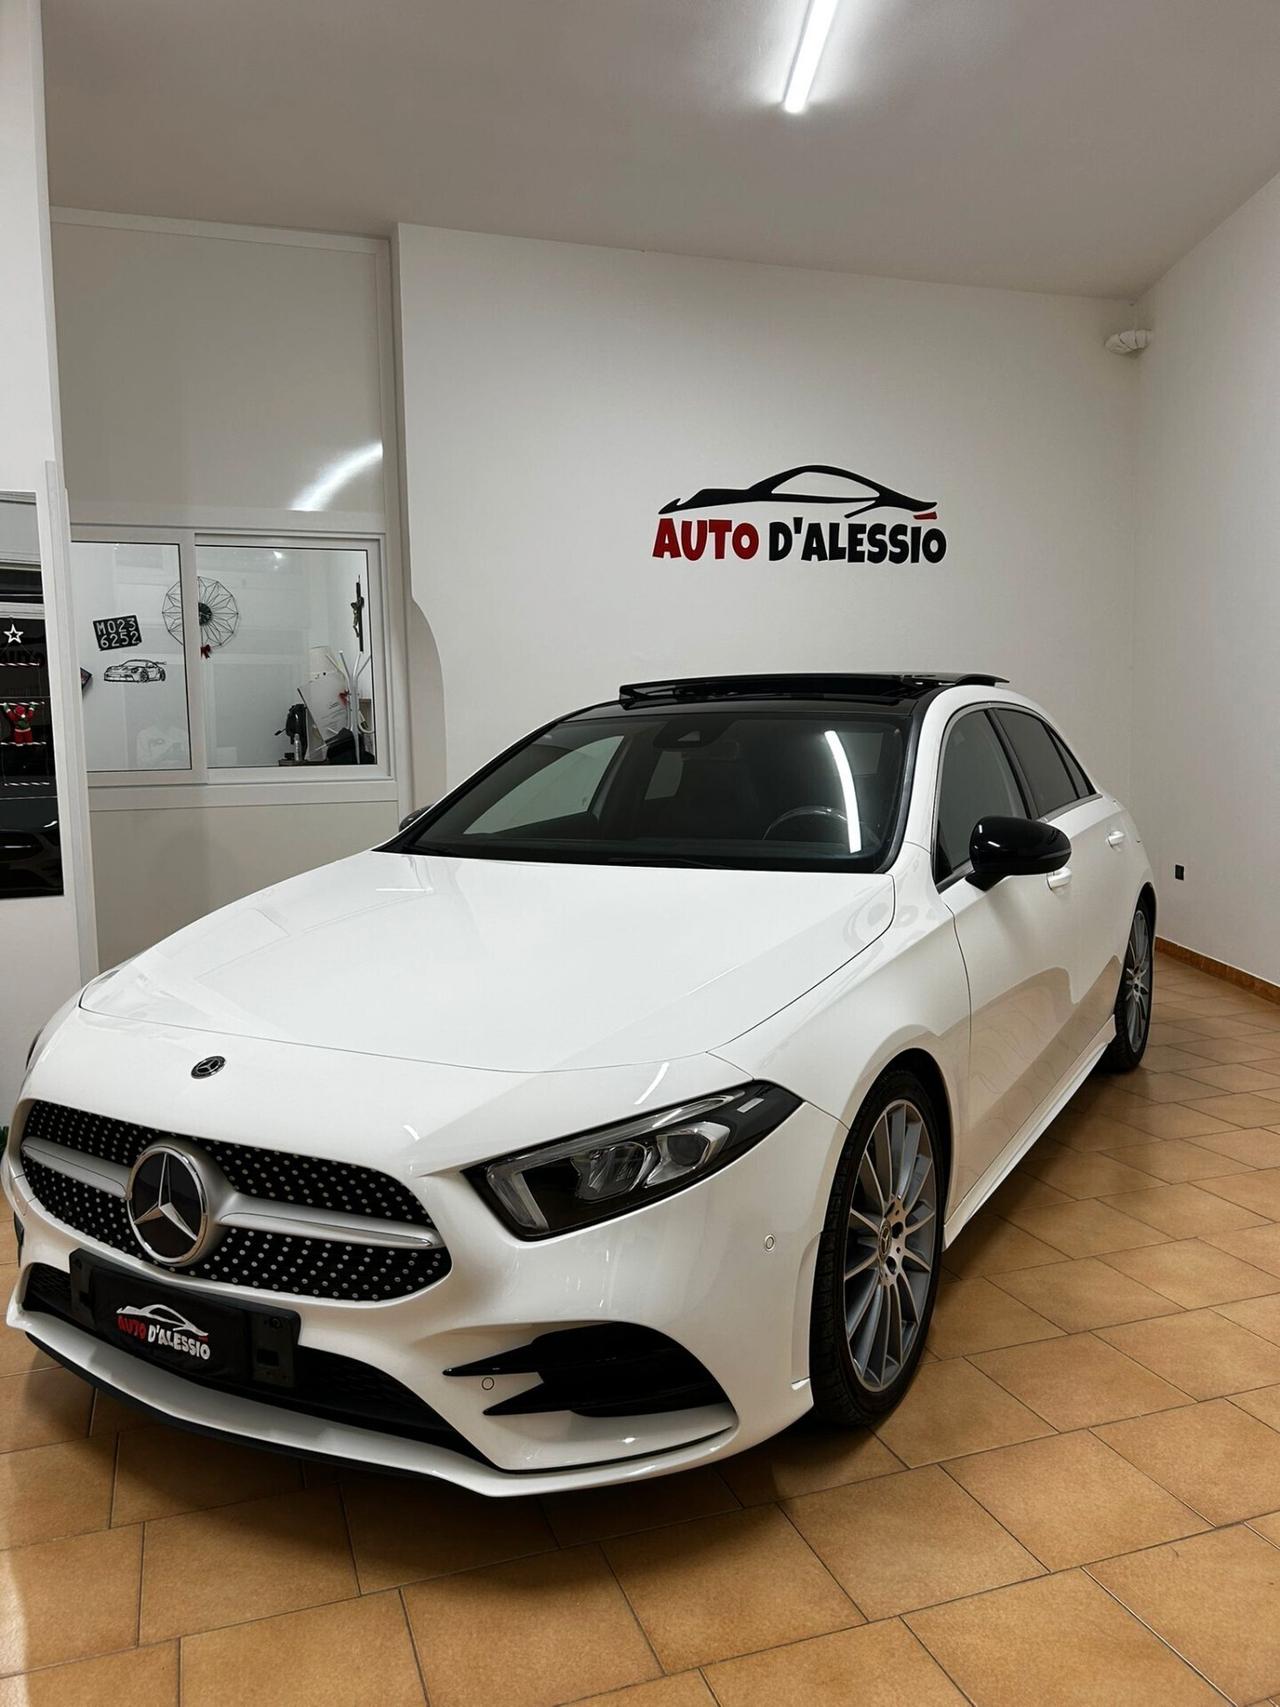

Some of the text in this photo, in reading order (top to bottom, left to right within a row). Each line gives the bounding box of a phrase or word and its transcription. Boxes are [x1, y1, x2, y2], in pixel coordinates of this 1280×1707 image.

[652, 516, 947, 564] AUTO D'ALESSIO
[100, 631, 139, 648] 6252
[117, 1316, 211, 1360] AUTO D'ALESSIO
